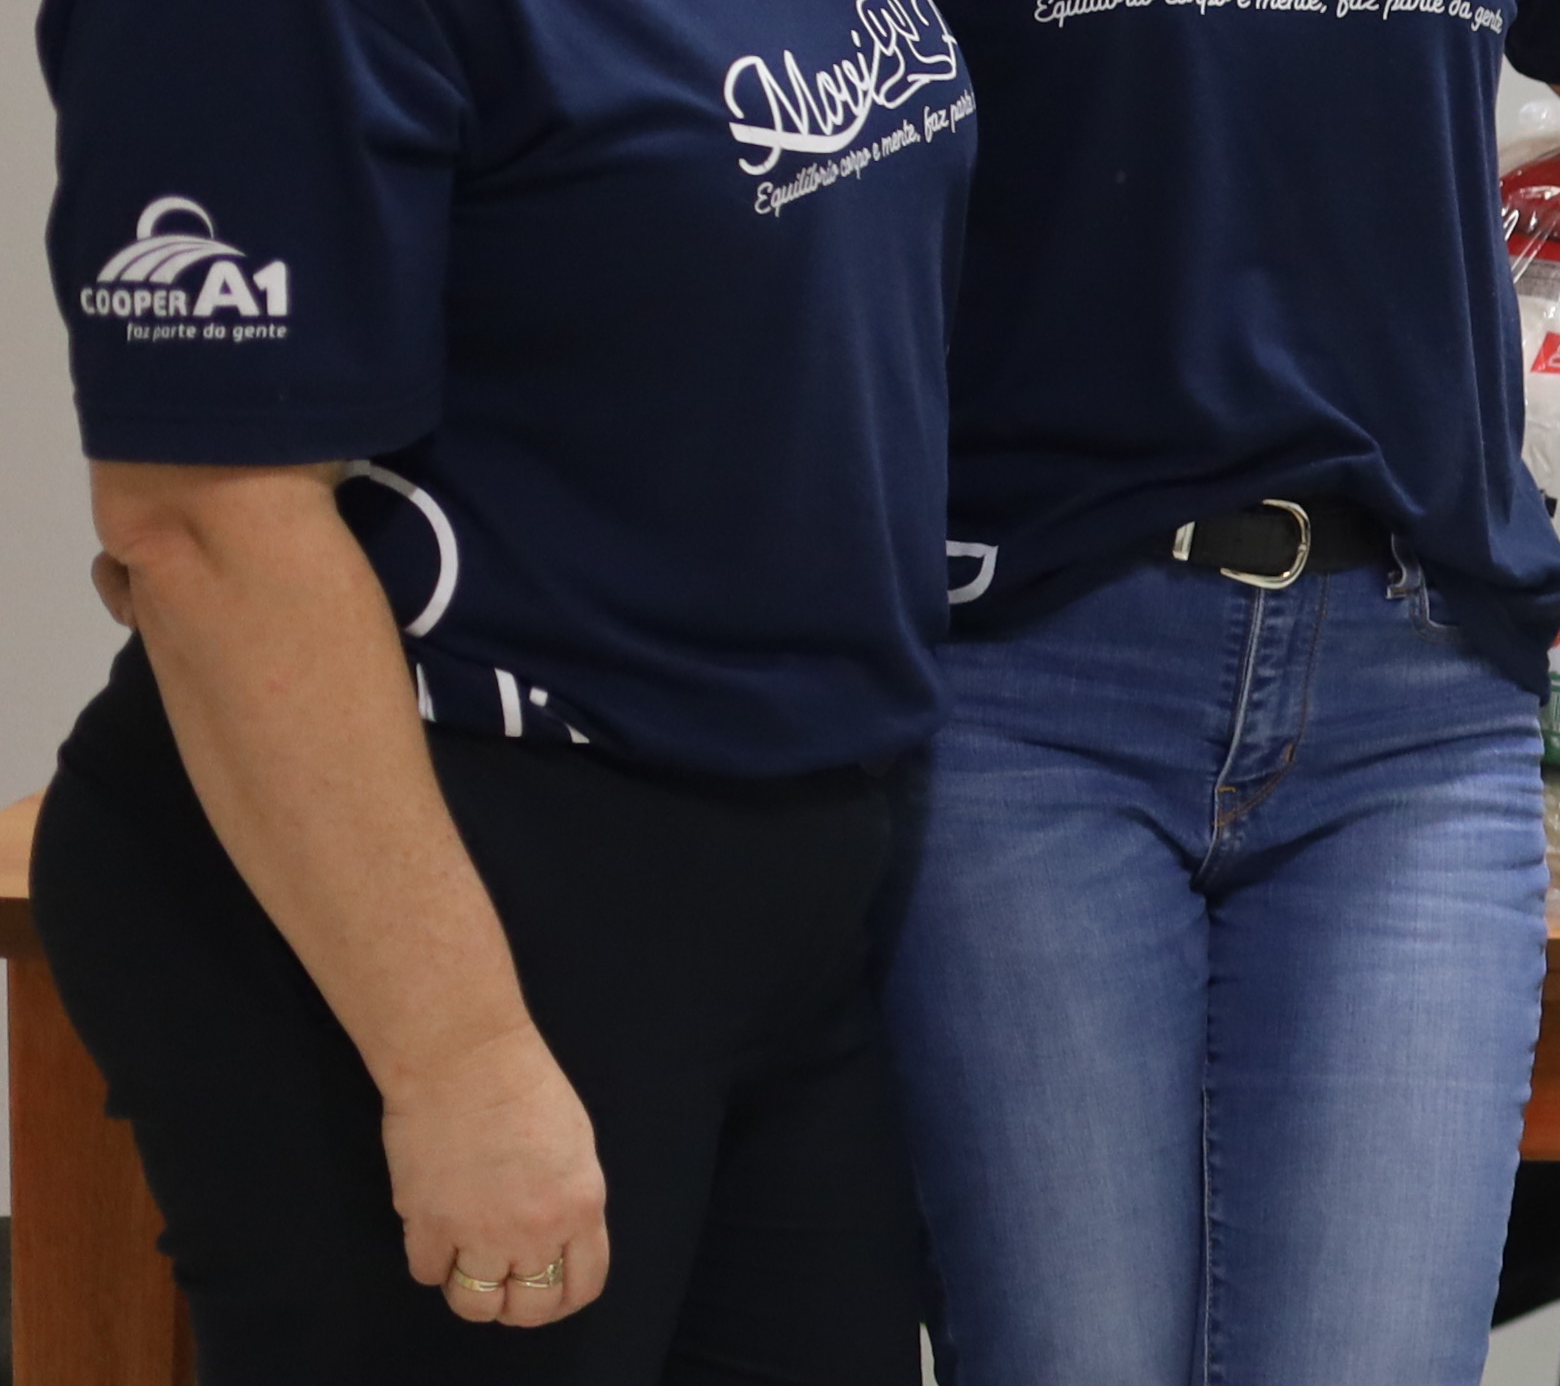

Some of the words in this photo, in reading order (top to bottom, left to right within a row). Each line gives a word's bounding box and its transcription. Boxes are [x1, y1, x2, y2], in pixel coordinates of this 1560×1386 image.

[840, 147, 872, 179] corpo
[872, 143, 881, 161] e
[923, 105, 949, 143] faz
[80, 287, 187, 317] COOPER
[192, 260, 287, 317] A1
[127, 323, 150, 341] faz
[152, 324, 196, 342] parte
[203, 323, 225, 339] da
[233, 323, 287, 343] gente
